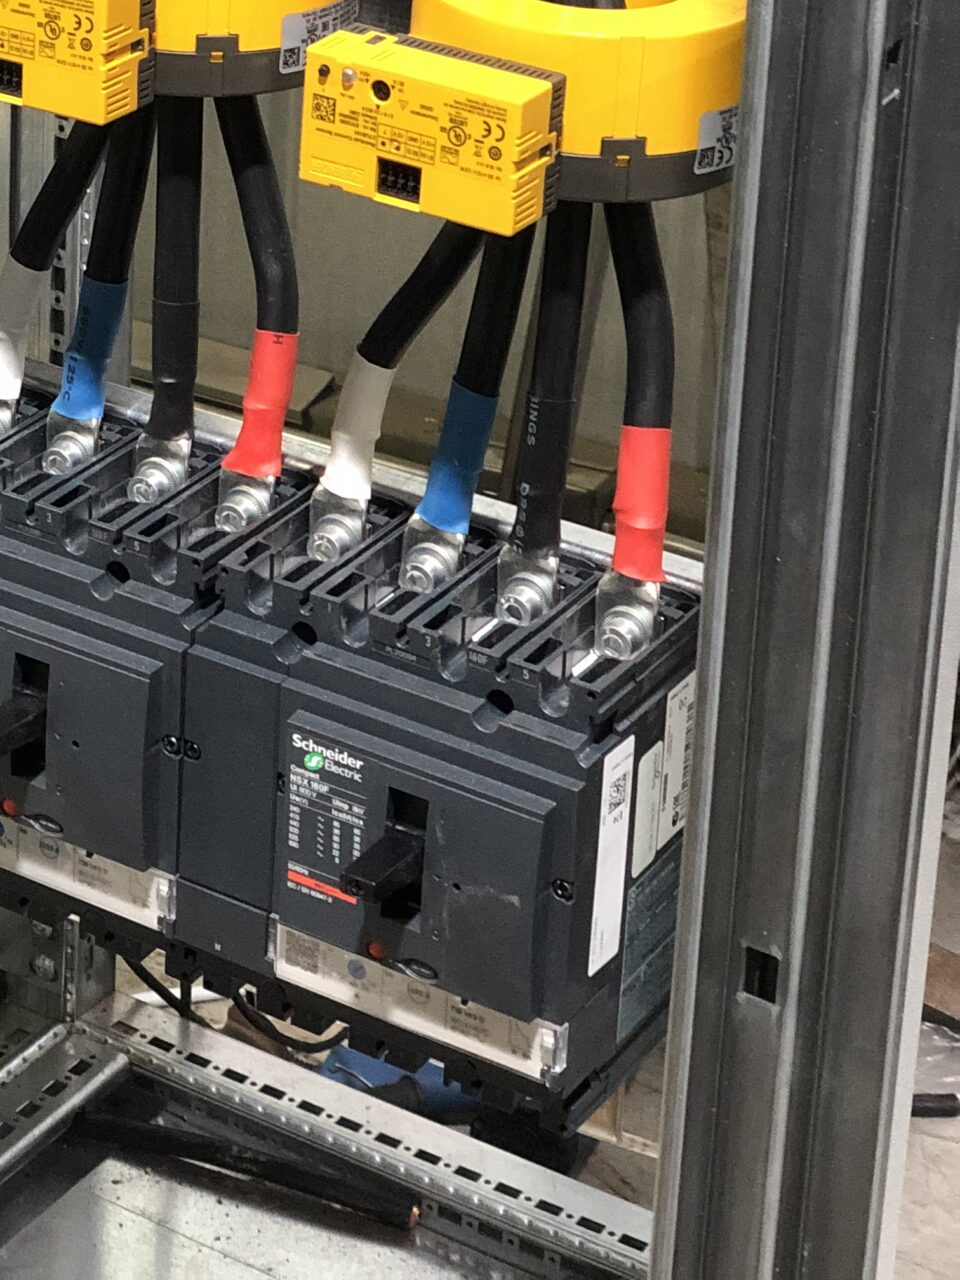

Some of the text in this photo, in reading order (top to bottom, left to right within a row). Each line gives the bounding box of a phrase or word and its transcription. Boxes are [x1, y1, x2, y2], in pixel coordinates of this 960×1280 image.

[46, 513, 52, 522] 3
[134, 541, 140, 551] 5
[425, 636, 431, 647] 3
[468, 652, 489, 665] 160F
[522, 669, 530, 680] 5
[292, 733, 364, 770] Schneider
[290, 764, 320, 780] Compact
[324, 760, 362, 783] Electric
[290, 773, 310, 787] NSX
